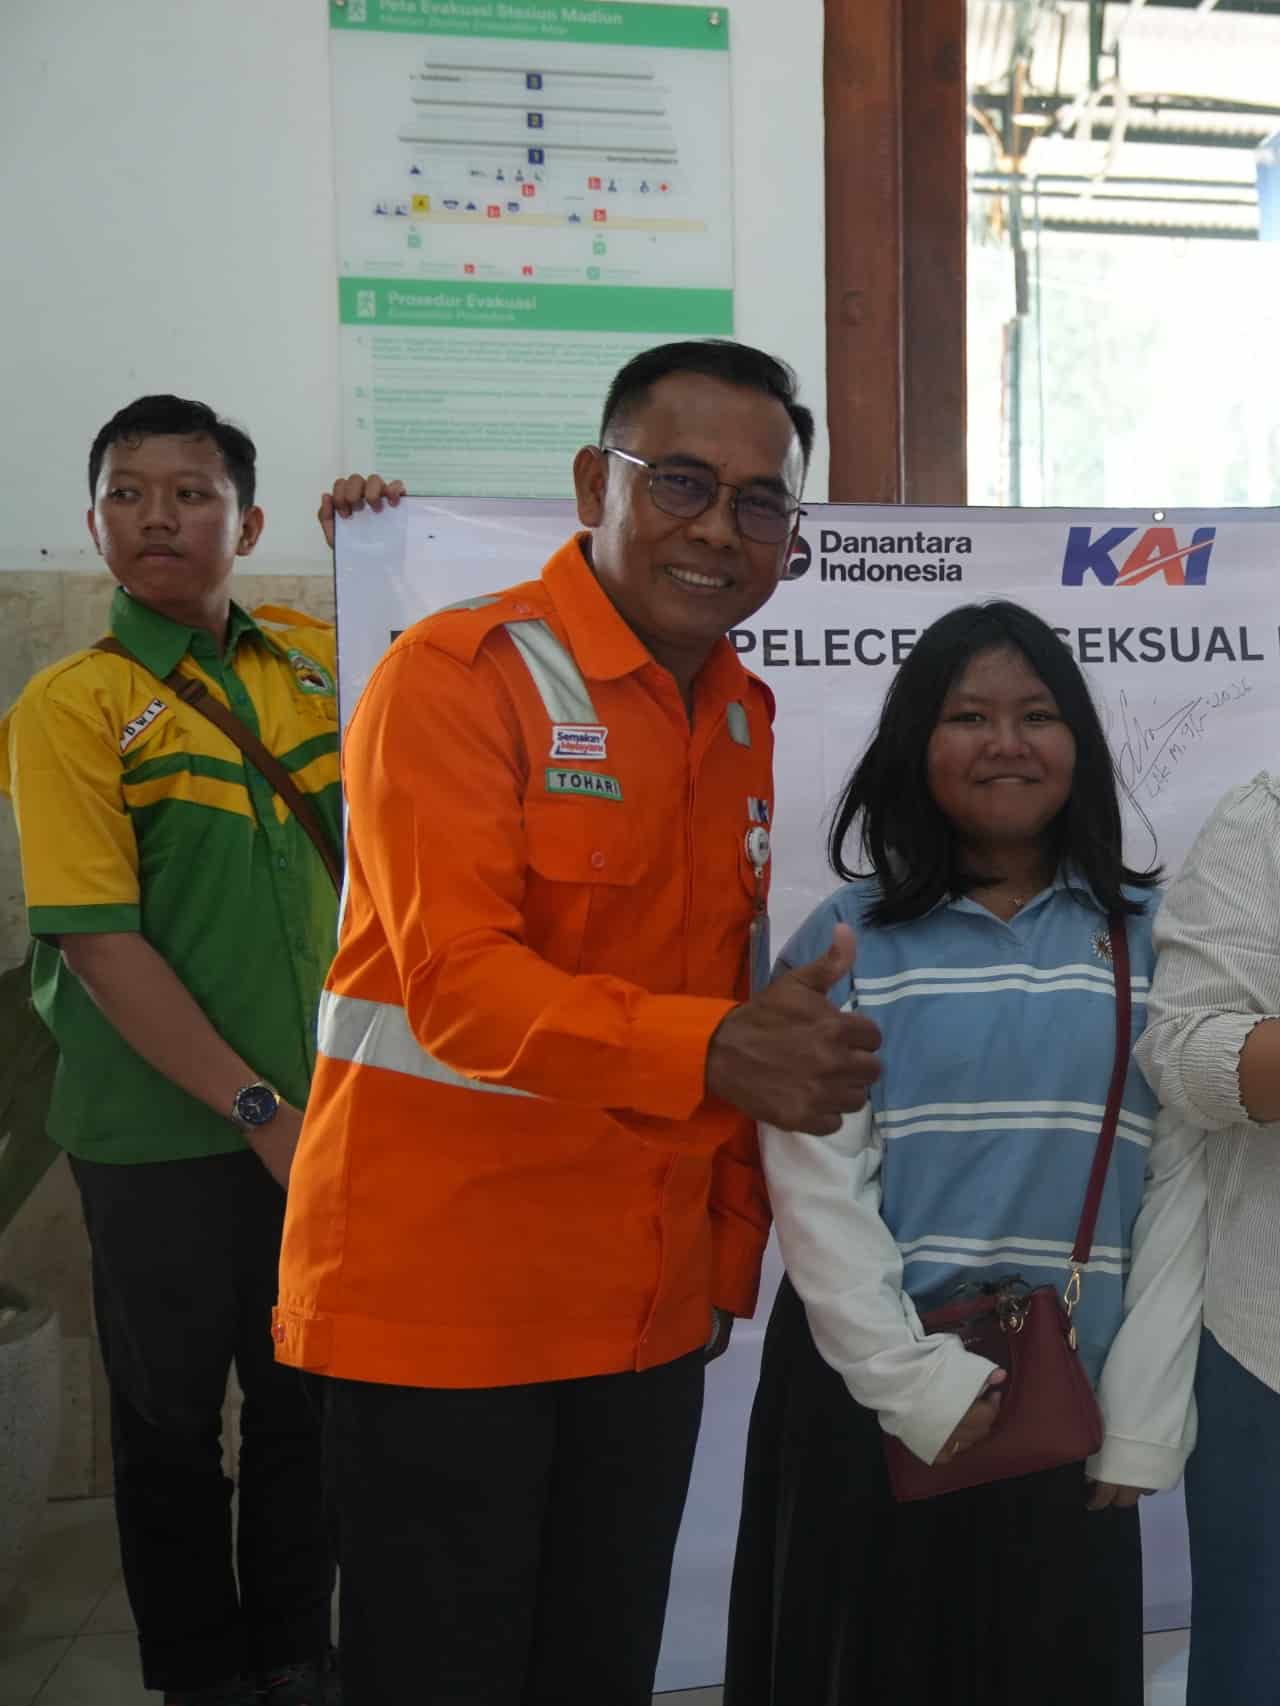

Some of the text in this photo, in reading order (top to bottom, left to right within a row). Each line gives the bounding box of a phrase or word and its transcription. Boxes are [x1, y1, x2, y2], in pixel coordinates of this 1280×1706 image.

[820, 529, 972, 554] Danantara
[1061, 526, 1217, 587] KAI
[820, 557, 963, 582] Indonesia
[728, 628, 928, 667] PELECE
[556, 731, 601, 744] Semakin
[557, 773, 619, 796] TOHARI
